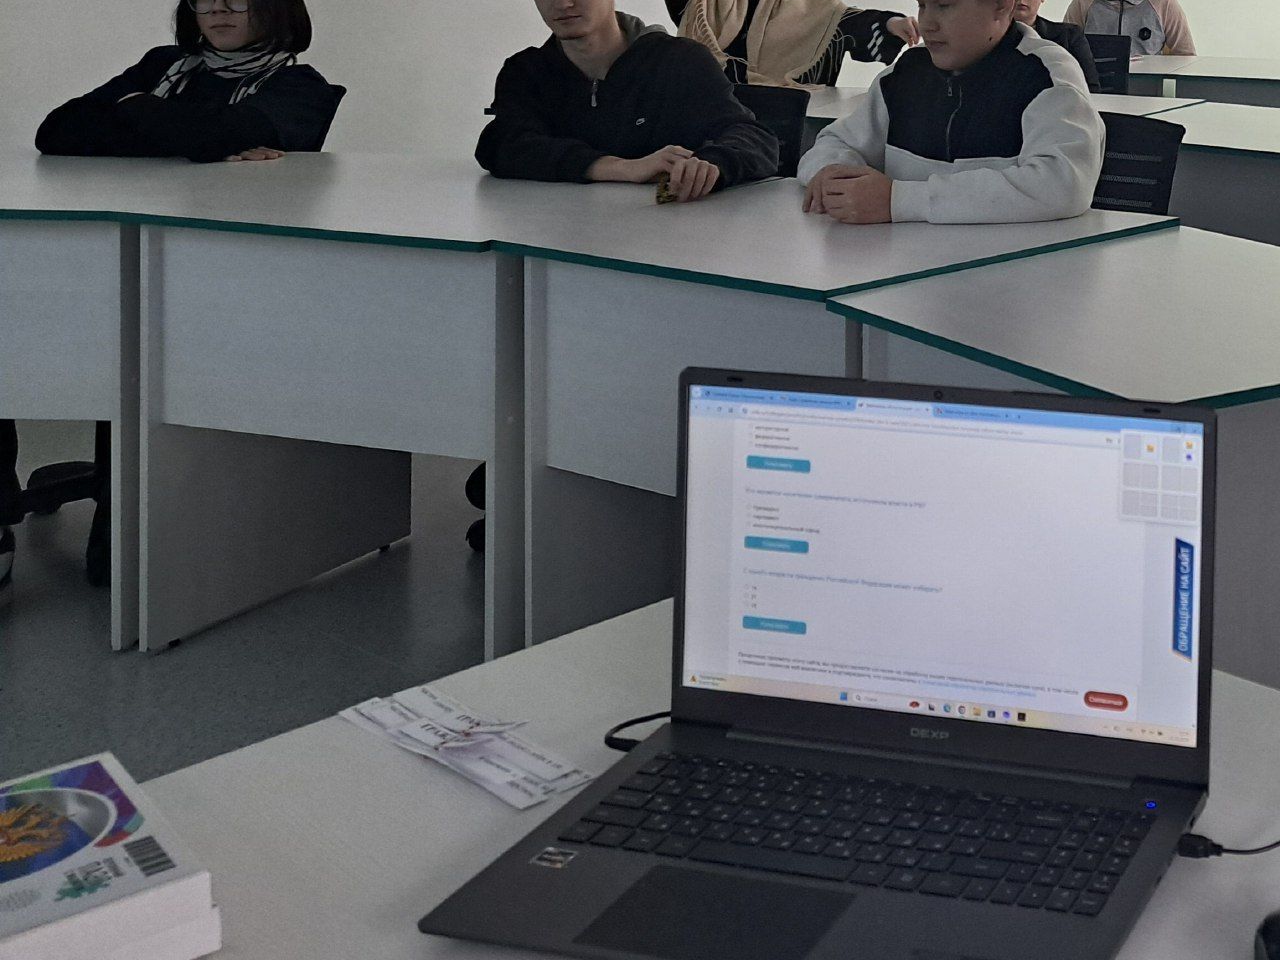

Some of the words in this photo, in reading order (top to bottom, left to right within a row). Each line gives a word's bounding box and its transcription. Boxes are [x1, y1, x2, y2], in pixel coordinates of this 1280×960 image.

[1178, 547, 1191, 574] САЙТ
[1179, 574, 1189, 590] НА
[1178, 592, 1190, 652] ОБРАЩЕНИЕ
[910, 728, 949, 739] DEXP
